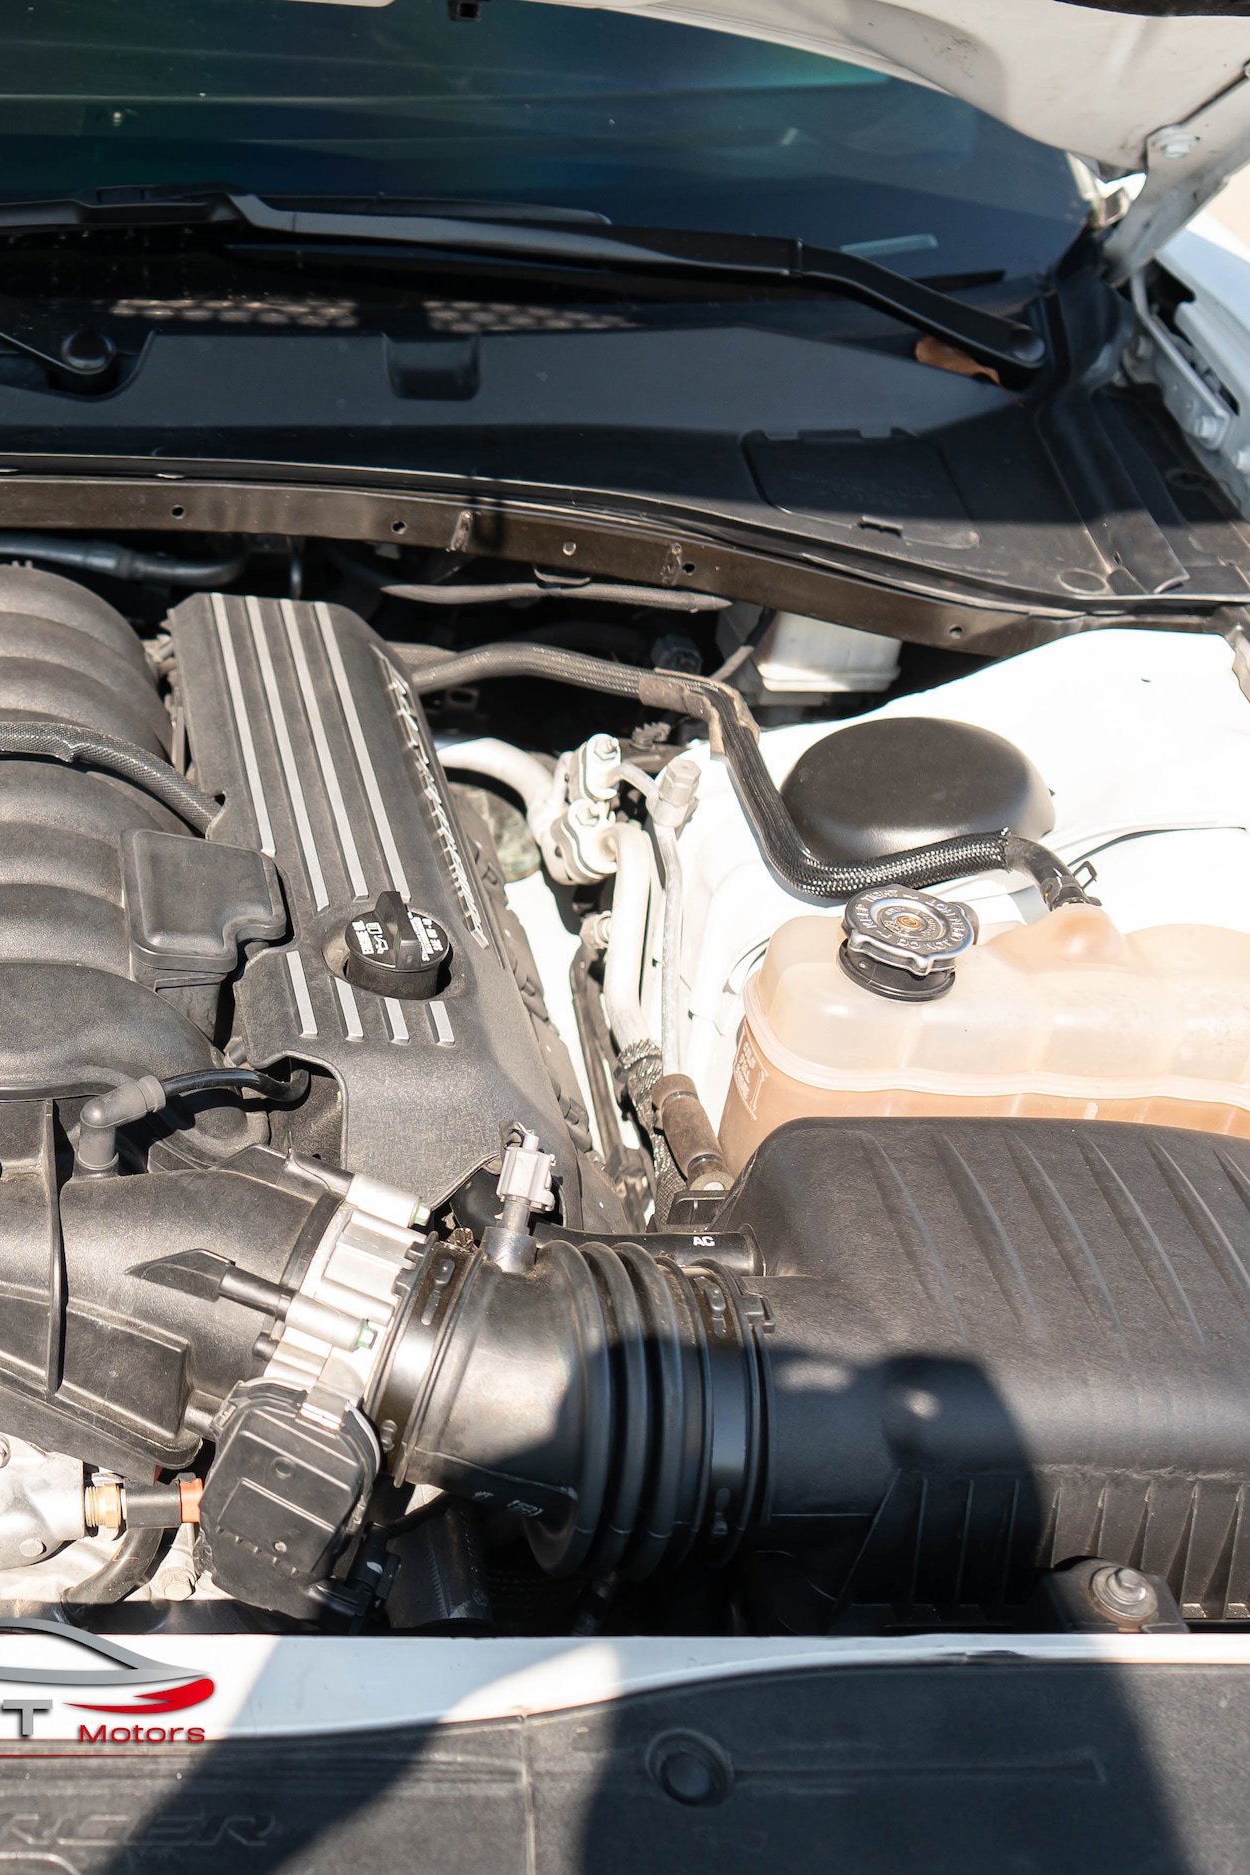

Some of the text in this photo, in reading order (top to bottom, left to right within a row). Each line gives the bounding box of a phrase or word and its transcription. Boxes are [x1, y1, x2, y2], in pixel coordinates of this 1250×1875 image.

[854, 889, 898, 929] KEEP TIGHT
[896, 938, 921, 949] DO
[924, 939, 952, 951] NOT
[693, 1236, 716, 1247] AC
